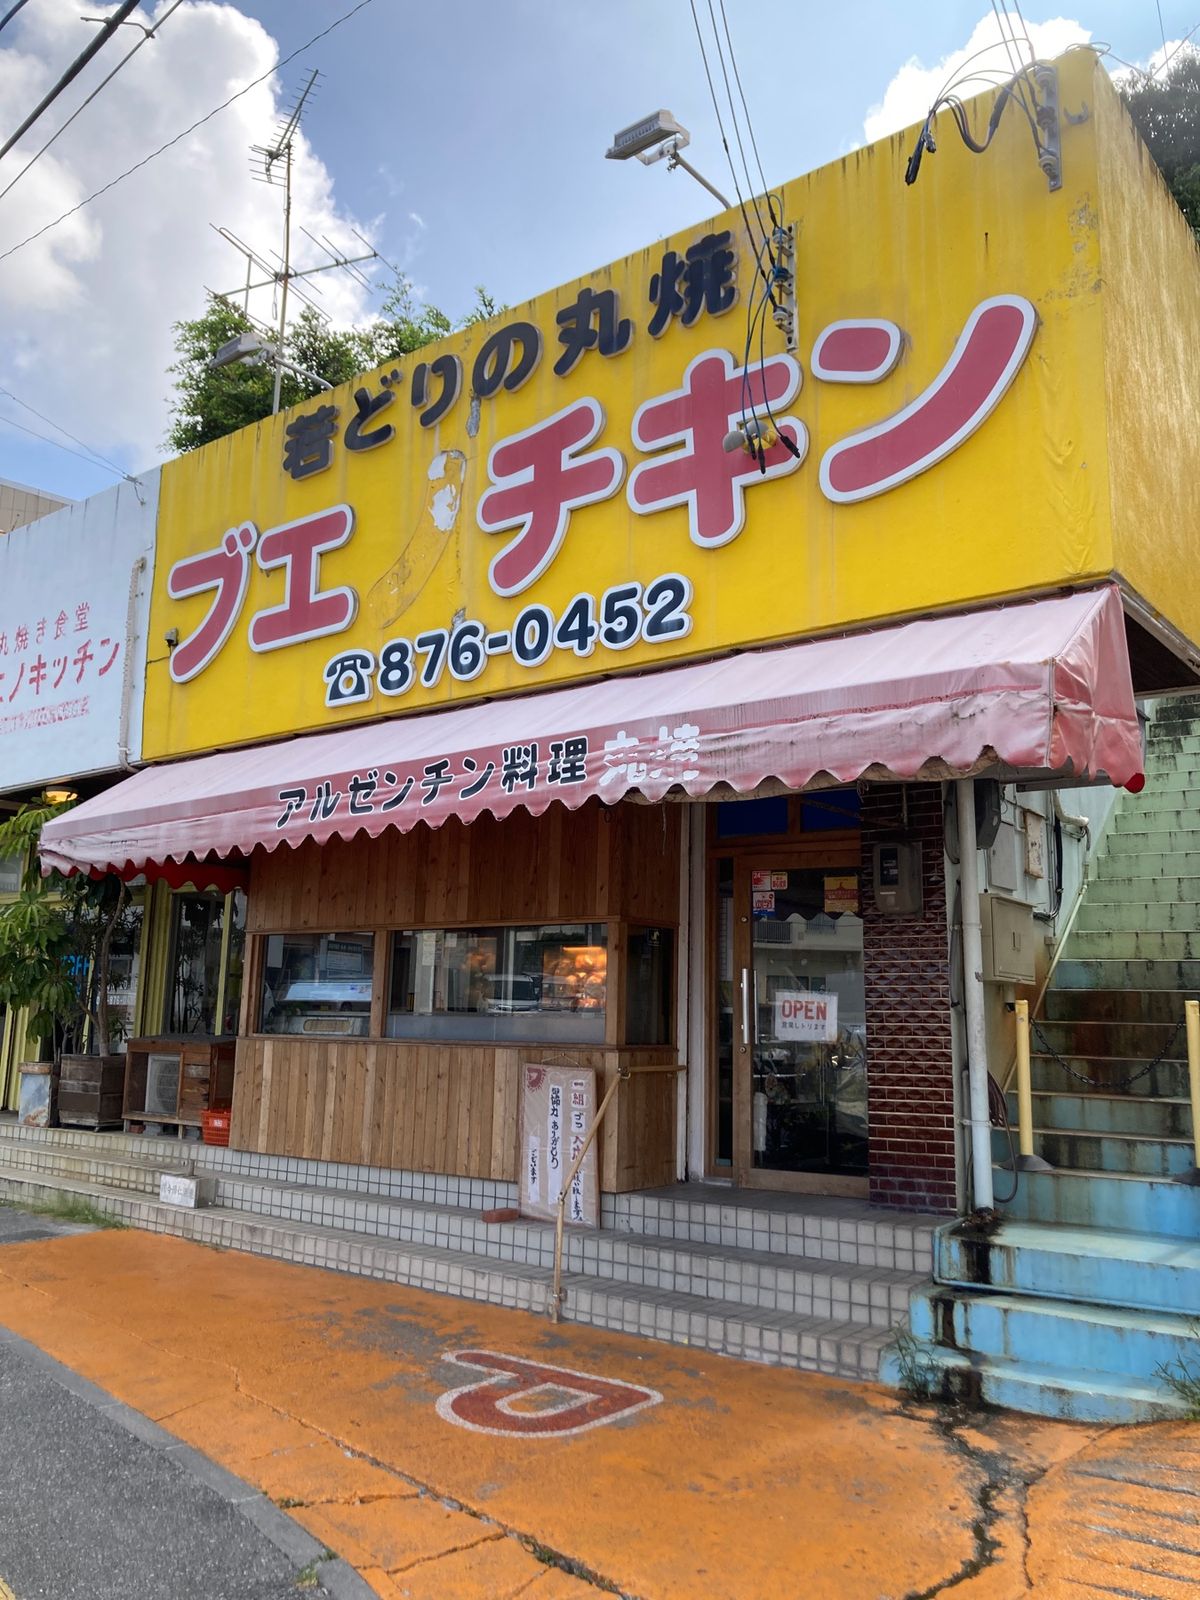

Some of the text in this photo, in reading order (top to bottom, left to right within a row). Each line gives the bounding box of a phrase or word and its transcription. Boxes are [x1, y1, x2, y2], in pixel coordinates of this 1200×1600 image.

[283, 230, 738, 480] 若どりの丸焼
[376, 572, 694, 698] 876-0452
[781, 999, 828, 1021] OPEN
